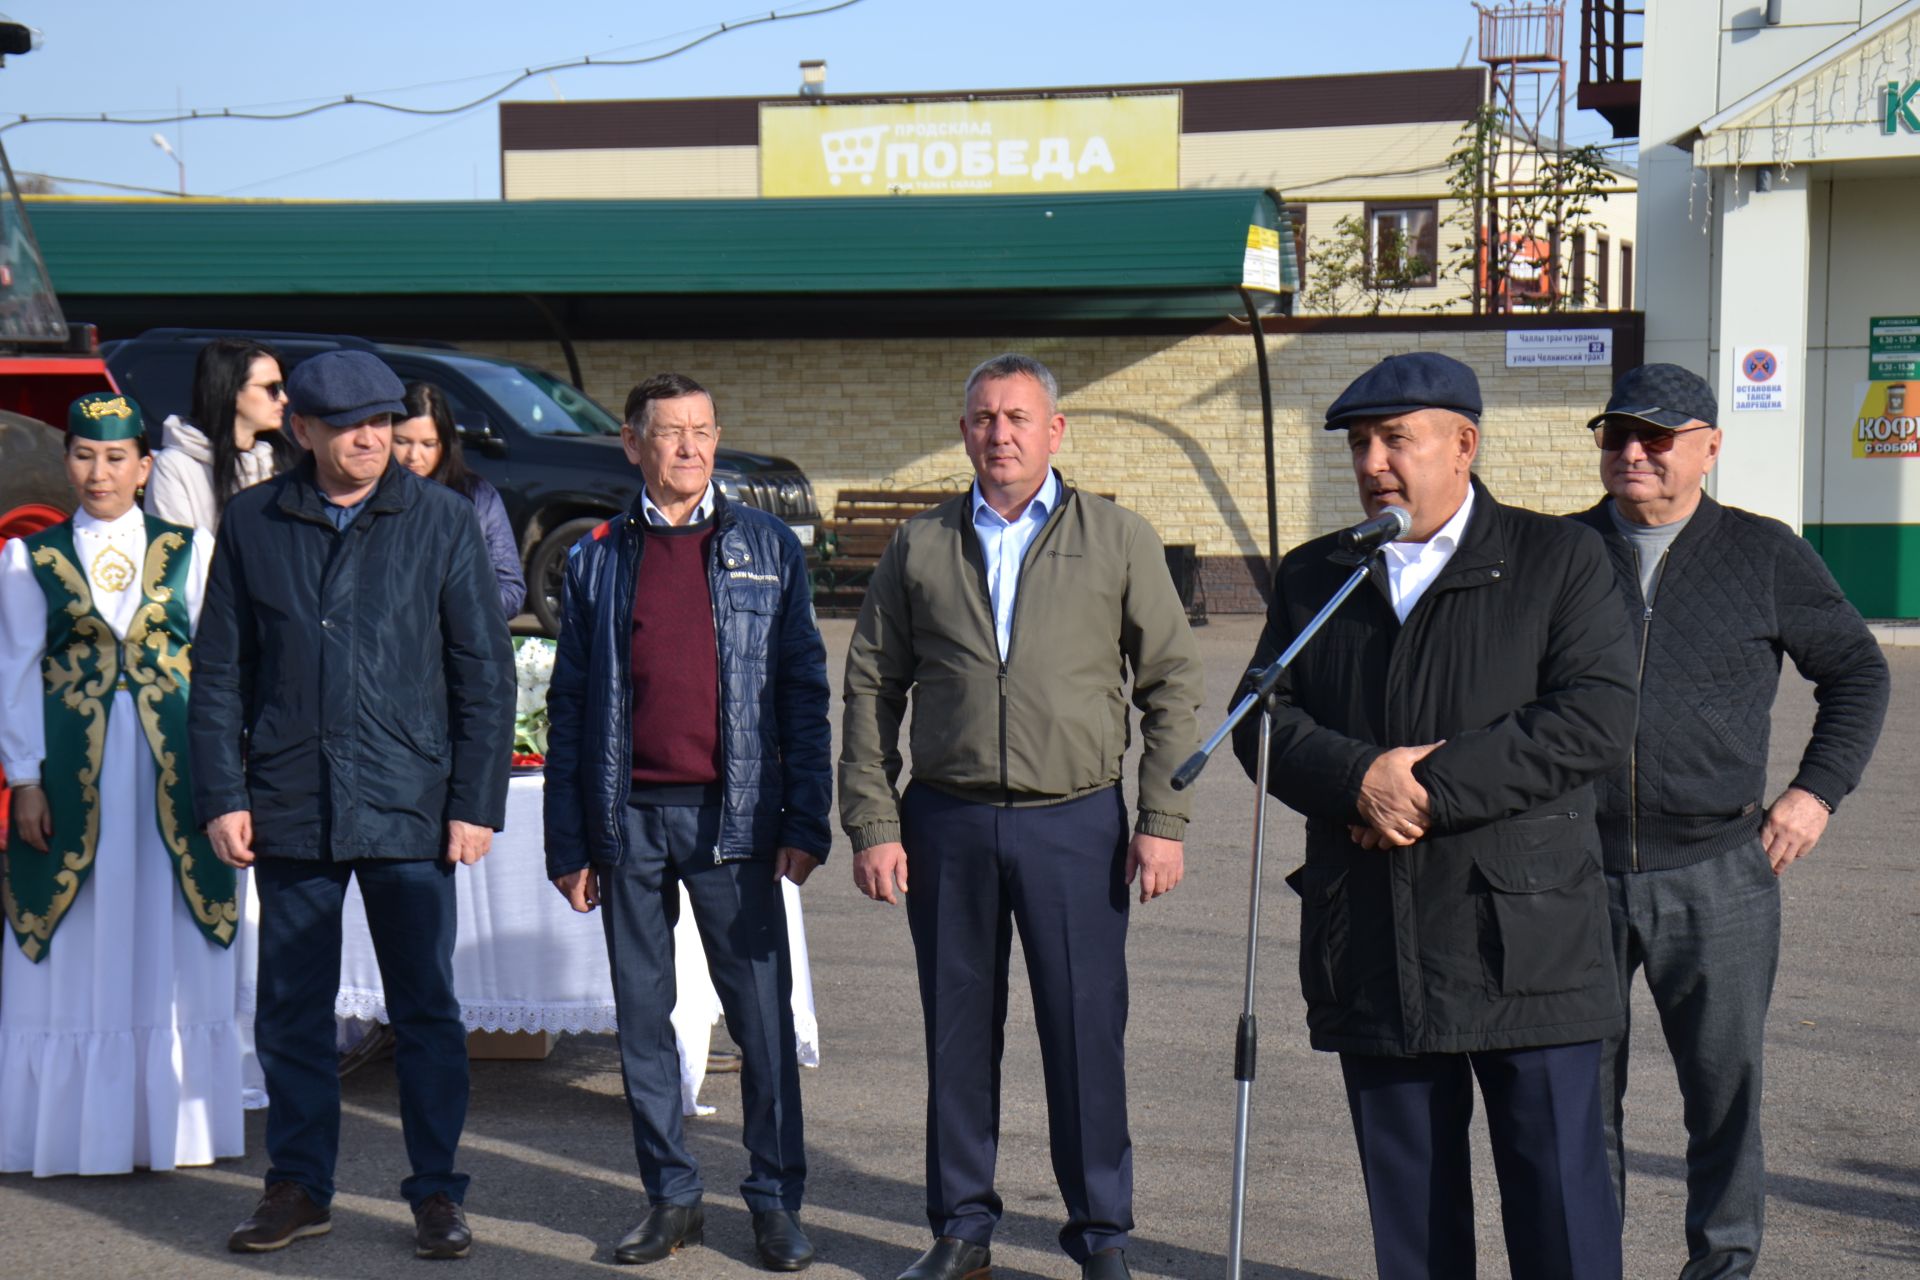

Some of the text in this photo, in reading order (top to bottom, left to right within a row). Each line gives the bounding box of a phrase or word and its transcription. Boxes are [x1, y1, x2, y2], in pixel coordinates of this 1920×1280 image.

[895, 122, 992, 135] ПРОДСКЛАД
[885, 136, 1116, 181] ПОБЕДА
[1513, 354, 1536, 364] улица
[1584, 352, 1605, 362] тракт
[1736, 401, 1782, 409] ЗАПРЕЩЕНА
